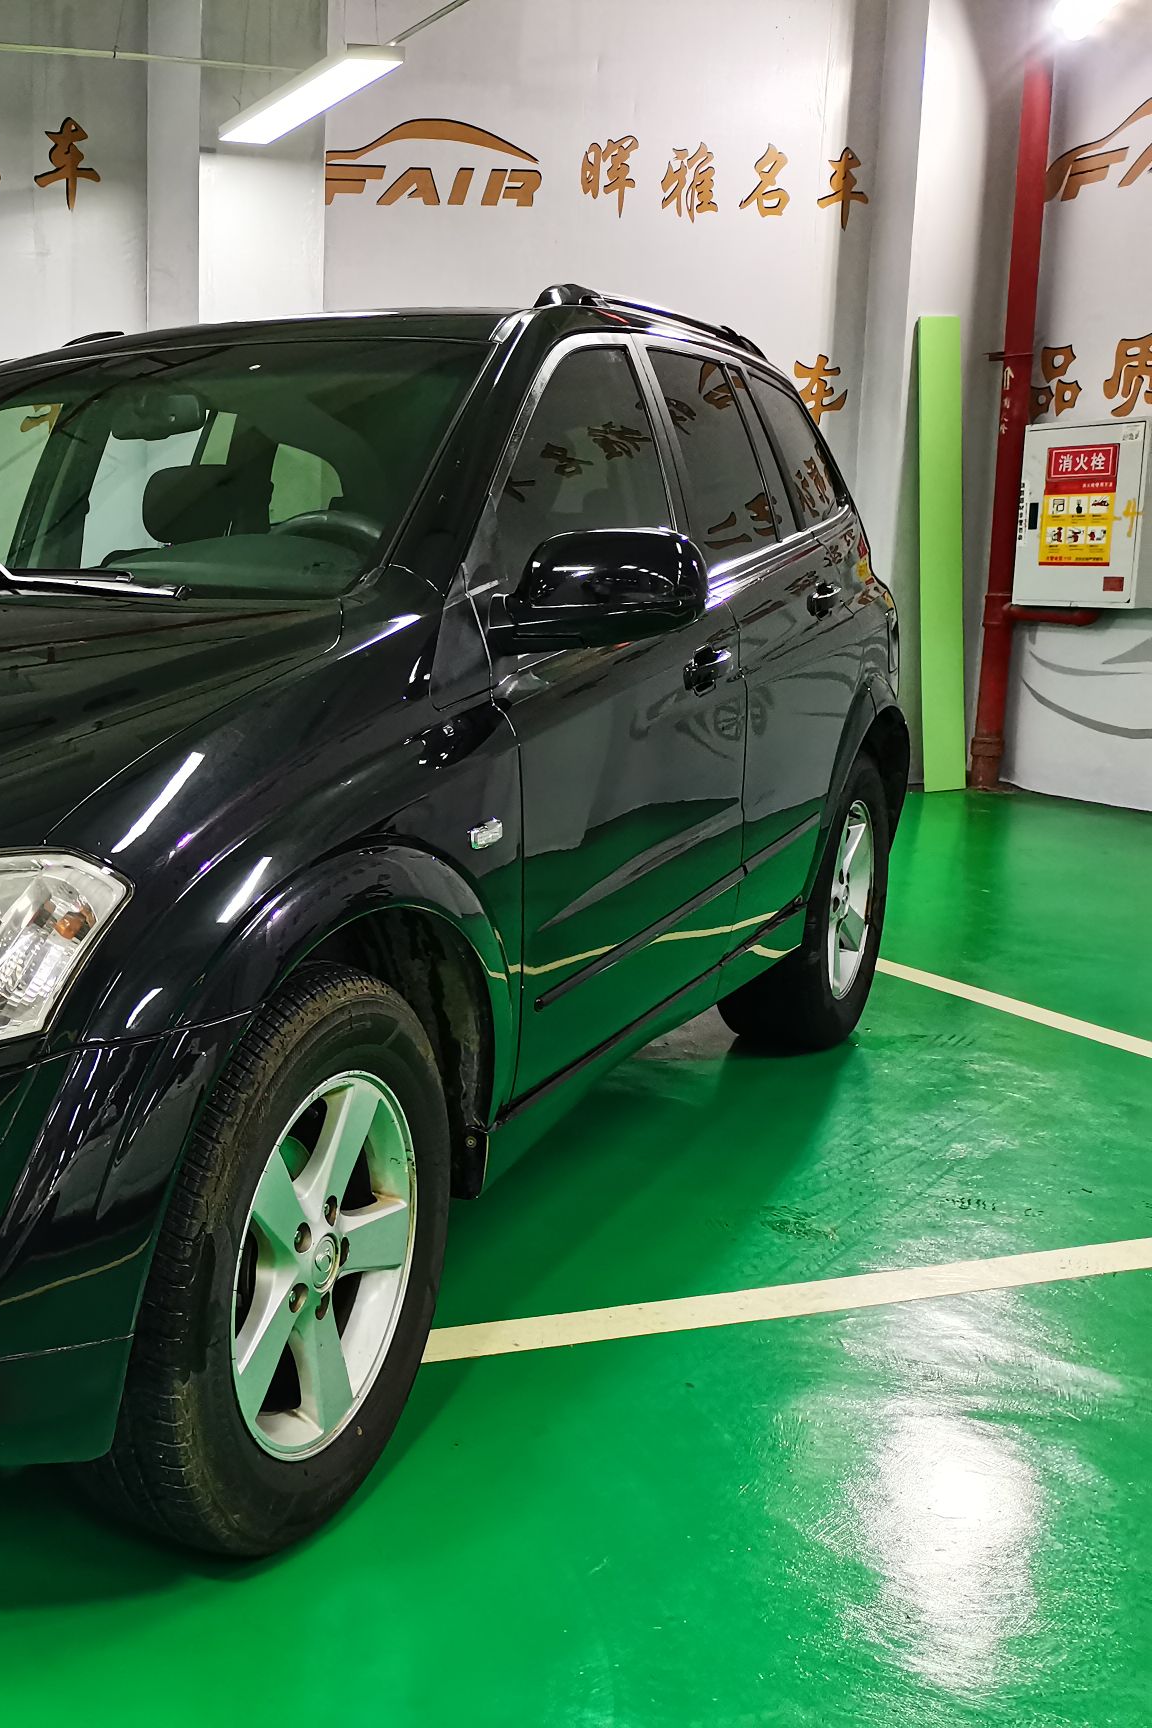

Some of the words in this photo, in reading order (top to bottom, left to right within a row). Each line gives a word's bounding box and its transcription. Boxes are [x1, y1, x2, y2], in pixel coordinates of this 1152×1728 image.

[325, 163, 542, 207] FAIR
[581, 135, 869, 232] 晖雅名车
[1058, 452, 1106, 473] 消火栓
